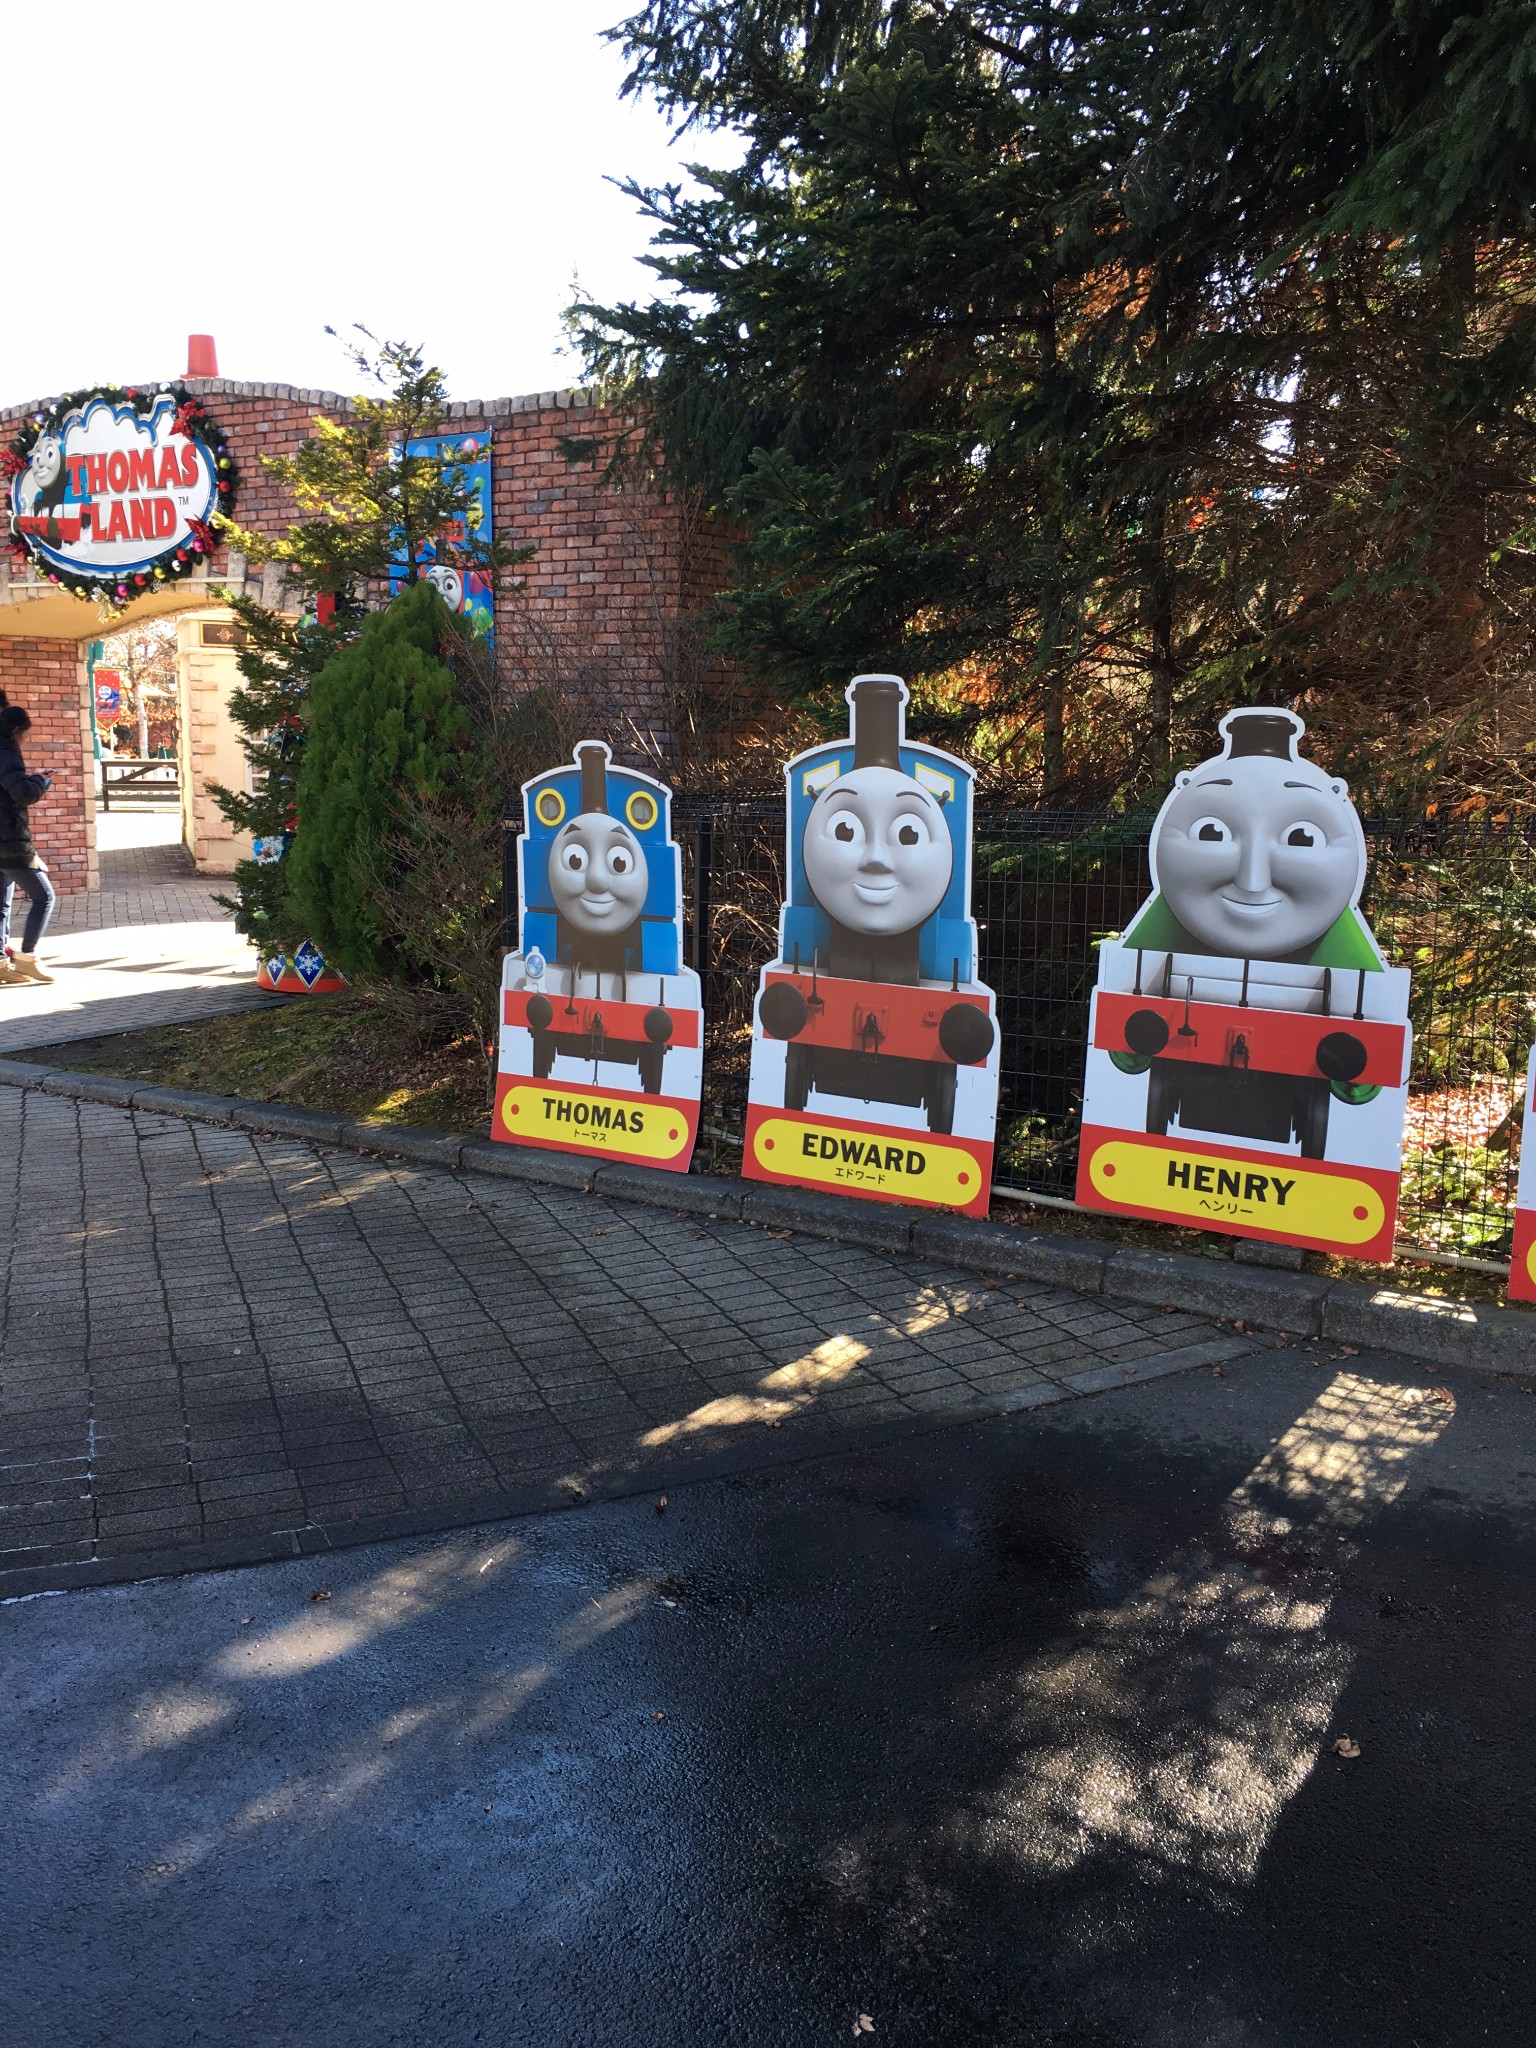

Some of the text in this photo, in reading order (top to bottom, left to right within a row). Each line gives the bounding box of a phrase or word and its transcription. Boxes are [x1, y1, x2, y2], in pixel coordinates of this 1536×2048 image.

[67, 443, 199, 496] THOMAS
[89, 496, 190, 543] LAND TM
[542, 1097, 644, 1134] THOMAS
[574, 1128, 607, 1143] トーマス
[802, 1132, 926, 1175] EDWARD
[834, 1167, 886, 1185] エドワード
[1167, 1160, 1296, 1205] HENRY
[1199, 1199, 1253, 1214] ヘンリー
